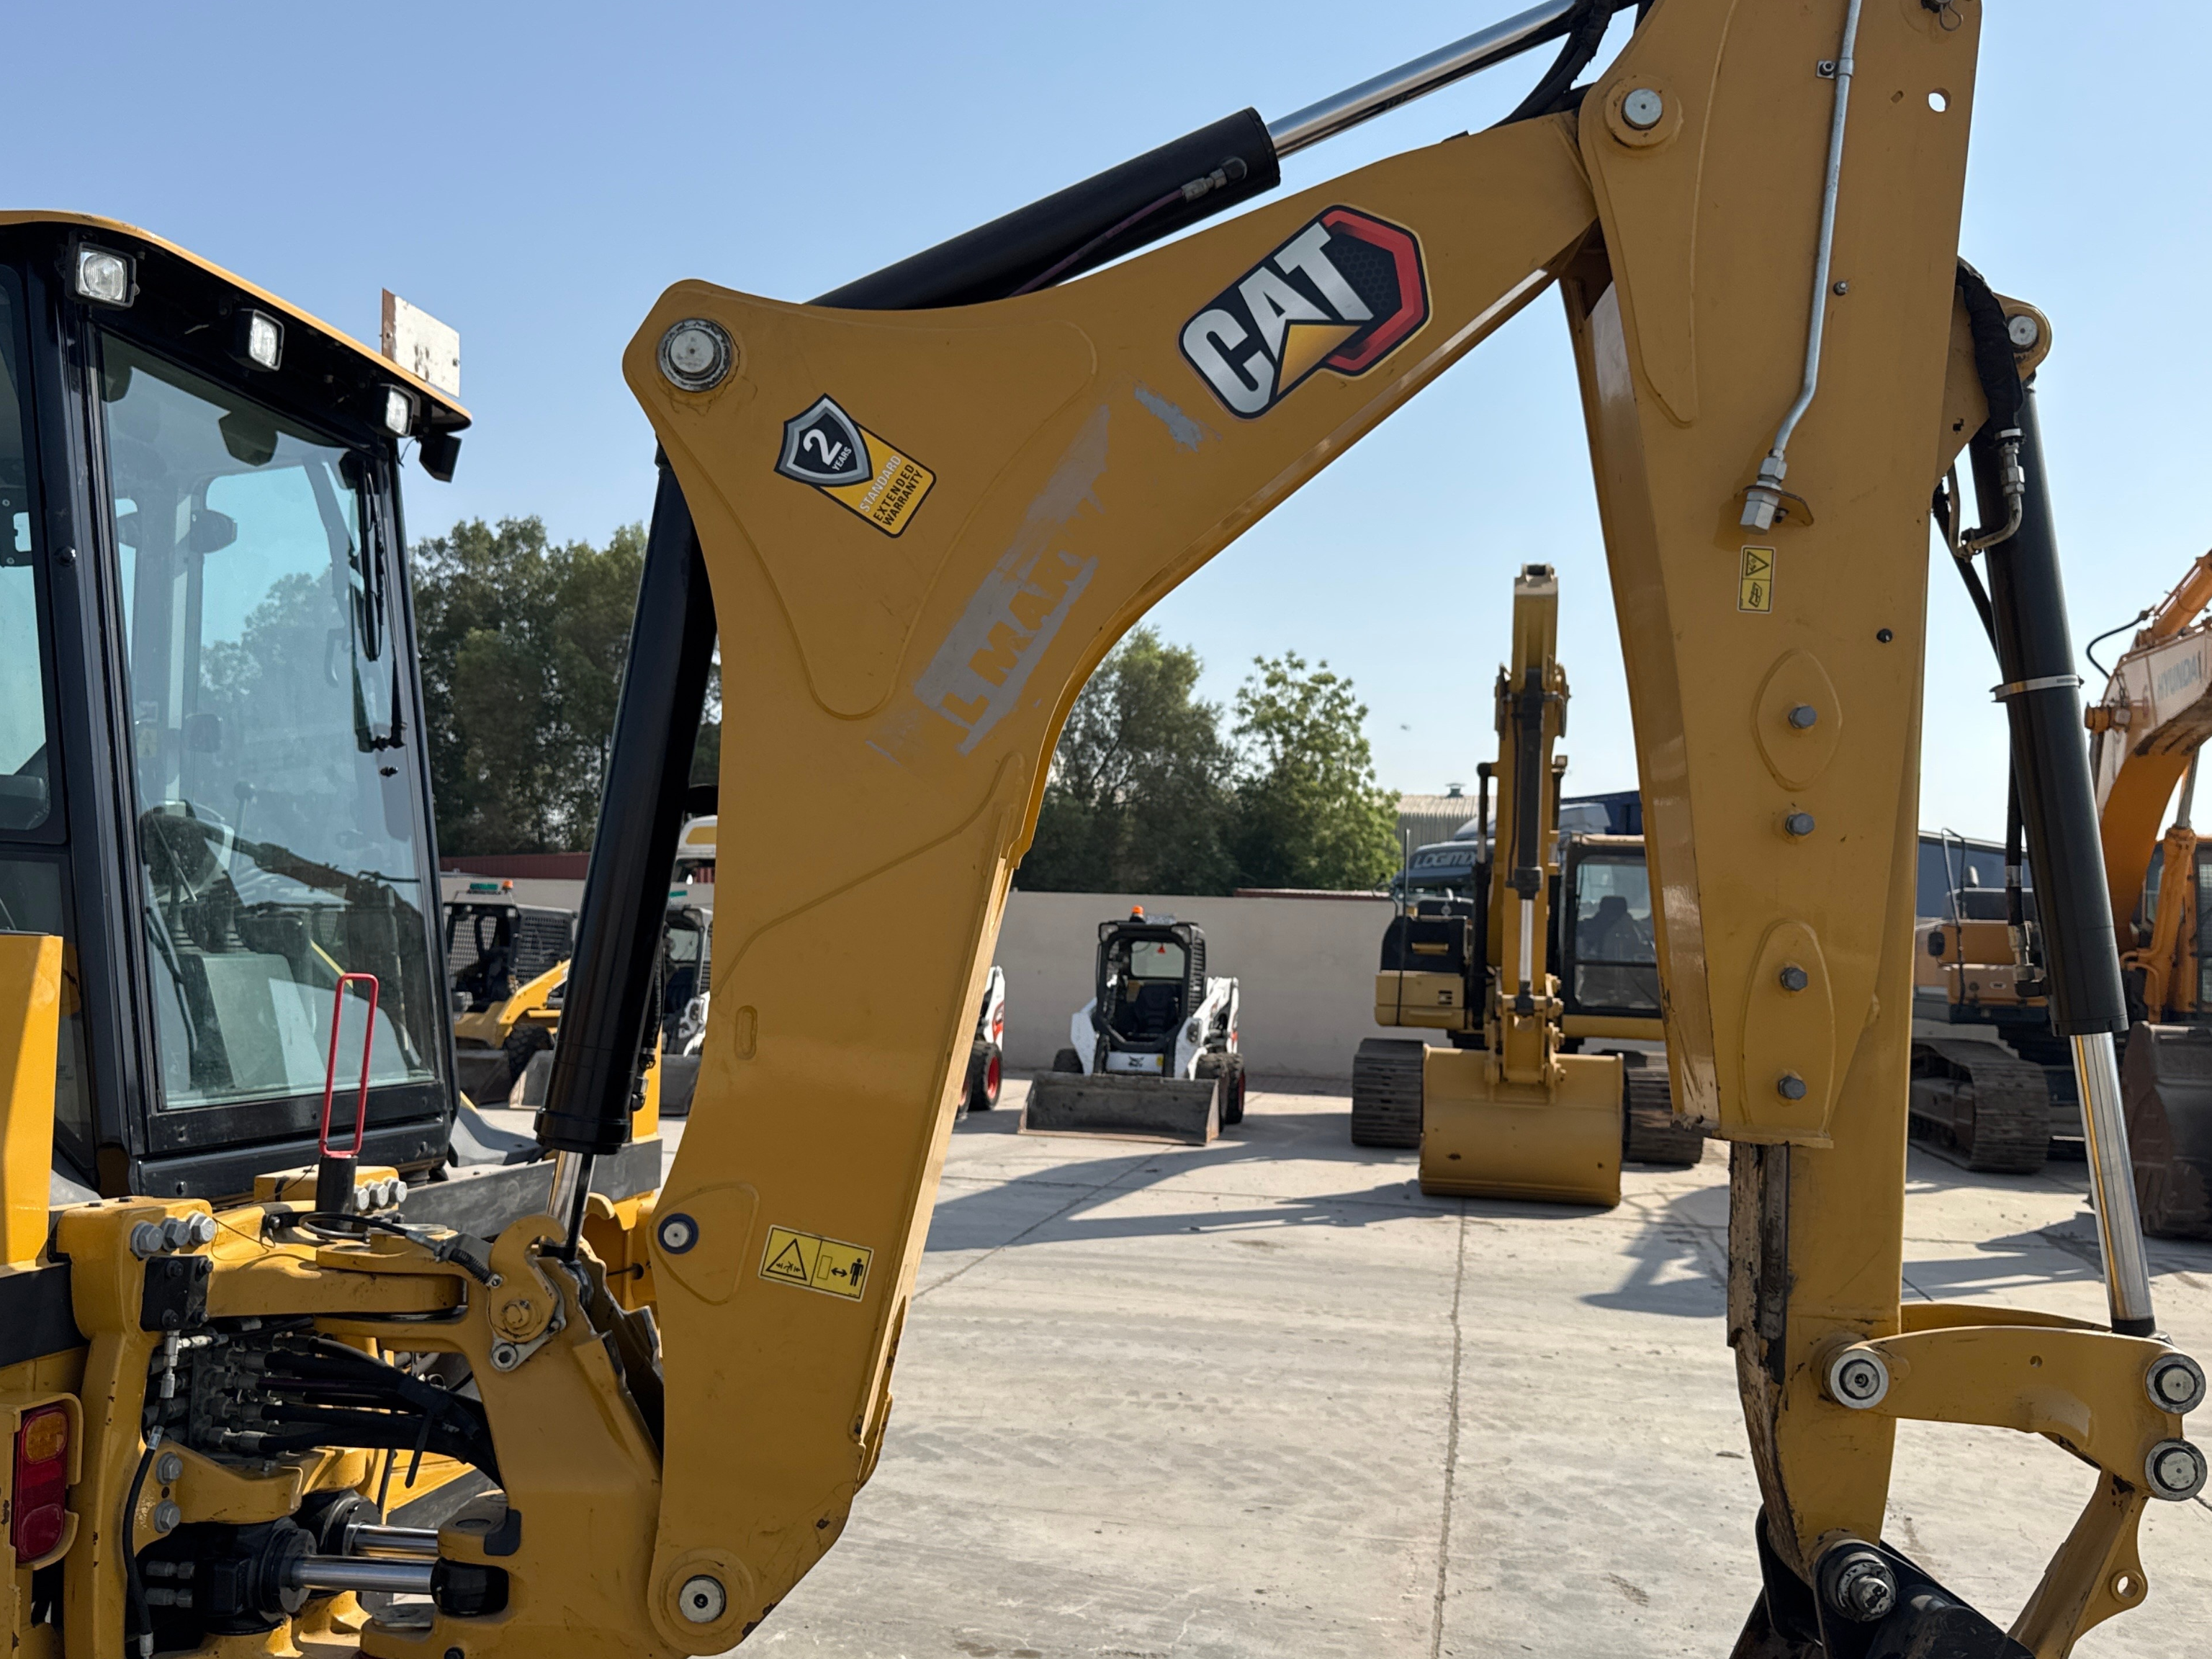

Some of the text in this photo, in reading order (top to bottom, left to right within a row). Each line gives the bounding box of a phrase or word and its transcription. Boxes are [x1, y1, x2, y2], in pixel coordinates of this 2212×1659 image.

[1183, 222, 1375, 413] CAT
[803, 428, 842, 466] 2
[832, 446, 853, 471] YEARS
[859, 455, 902, 512] STANDARD
[873, 463, 915, 522] EXTENDED
[882, 469, 923, 526] WARRANTY
[2158, 650, 2203, 701] HYUNDAI
